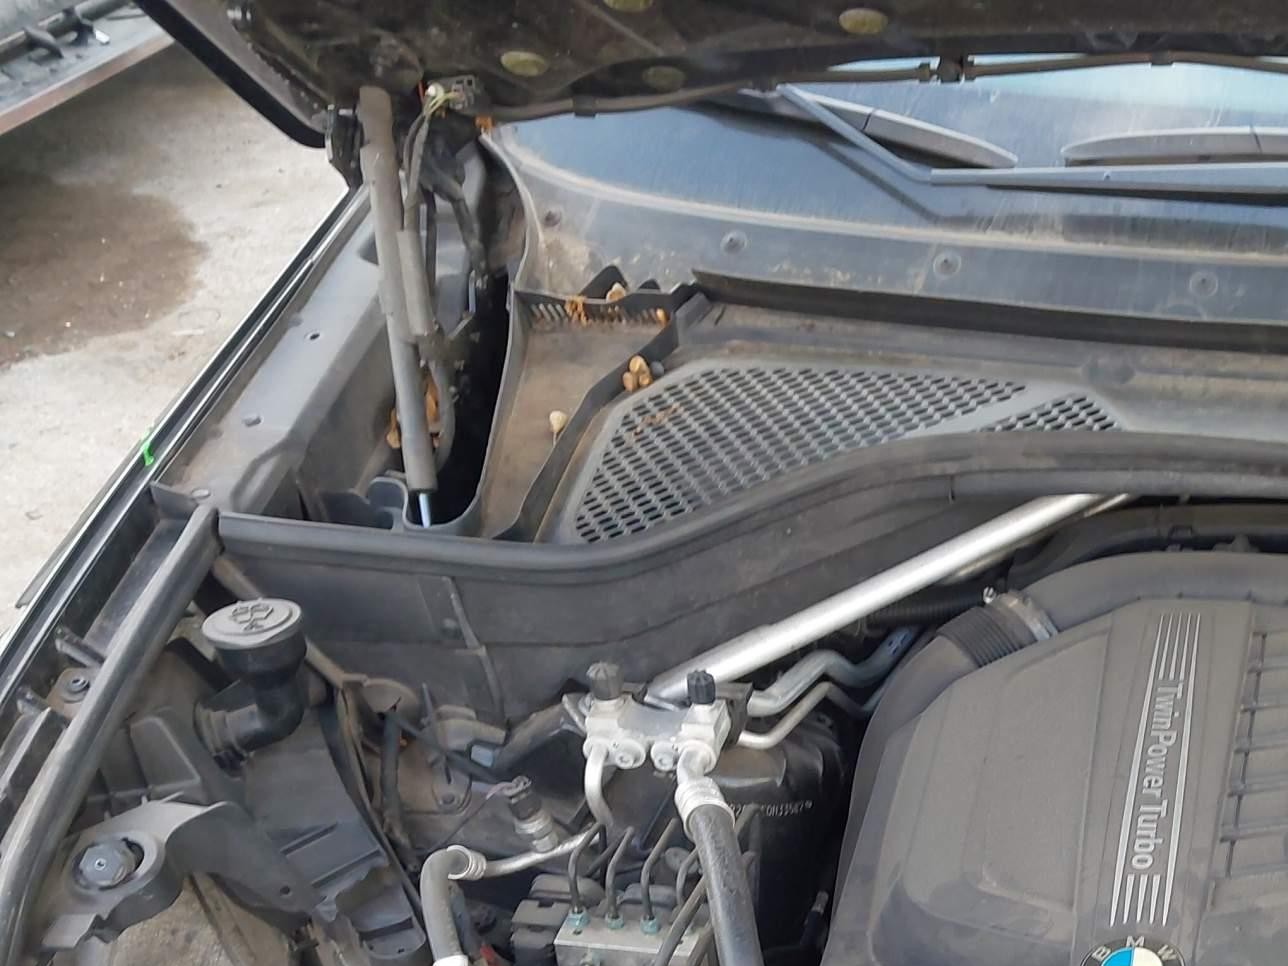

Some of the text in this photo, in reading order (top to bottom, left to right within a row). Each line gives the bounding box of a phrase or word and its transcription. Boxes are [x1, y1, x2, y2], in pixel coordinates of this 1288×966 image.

[1132, 682, 1184, 870] TwinPower Turbo
[1091, 935, 1177, 962] BMW
